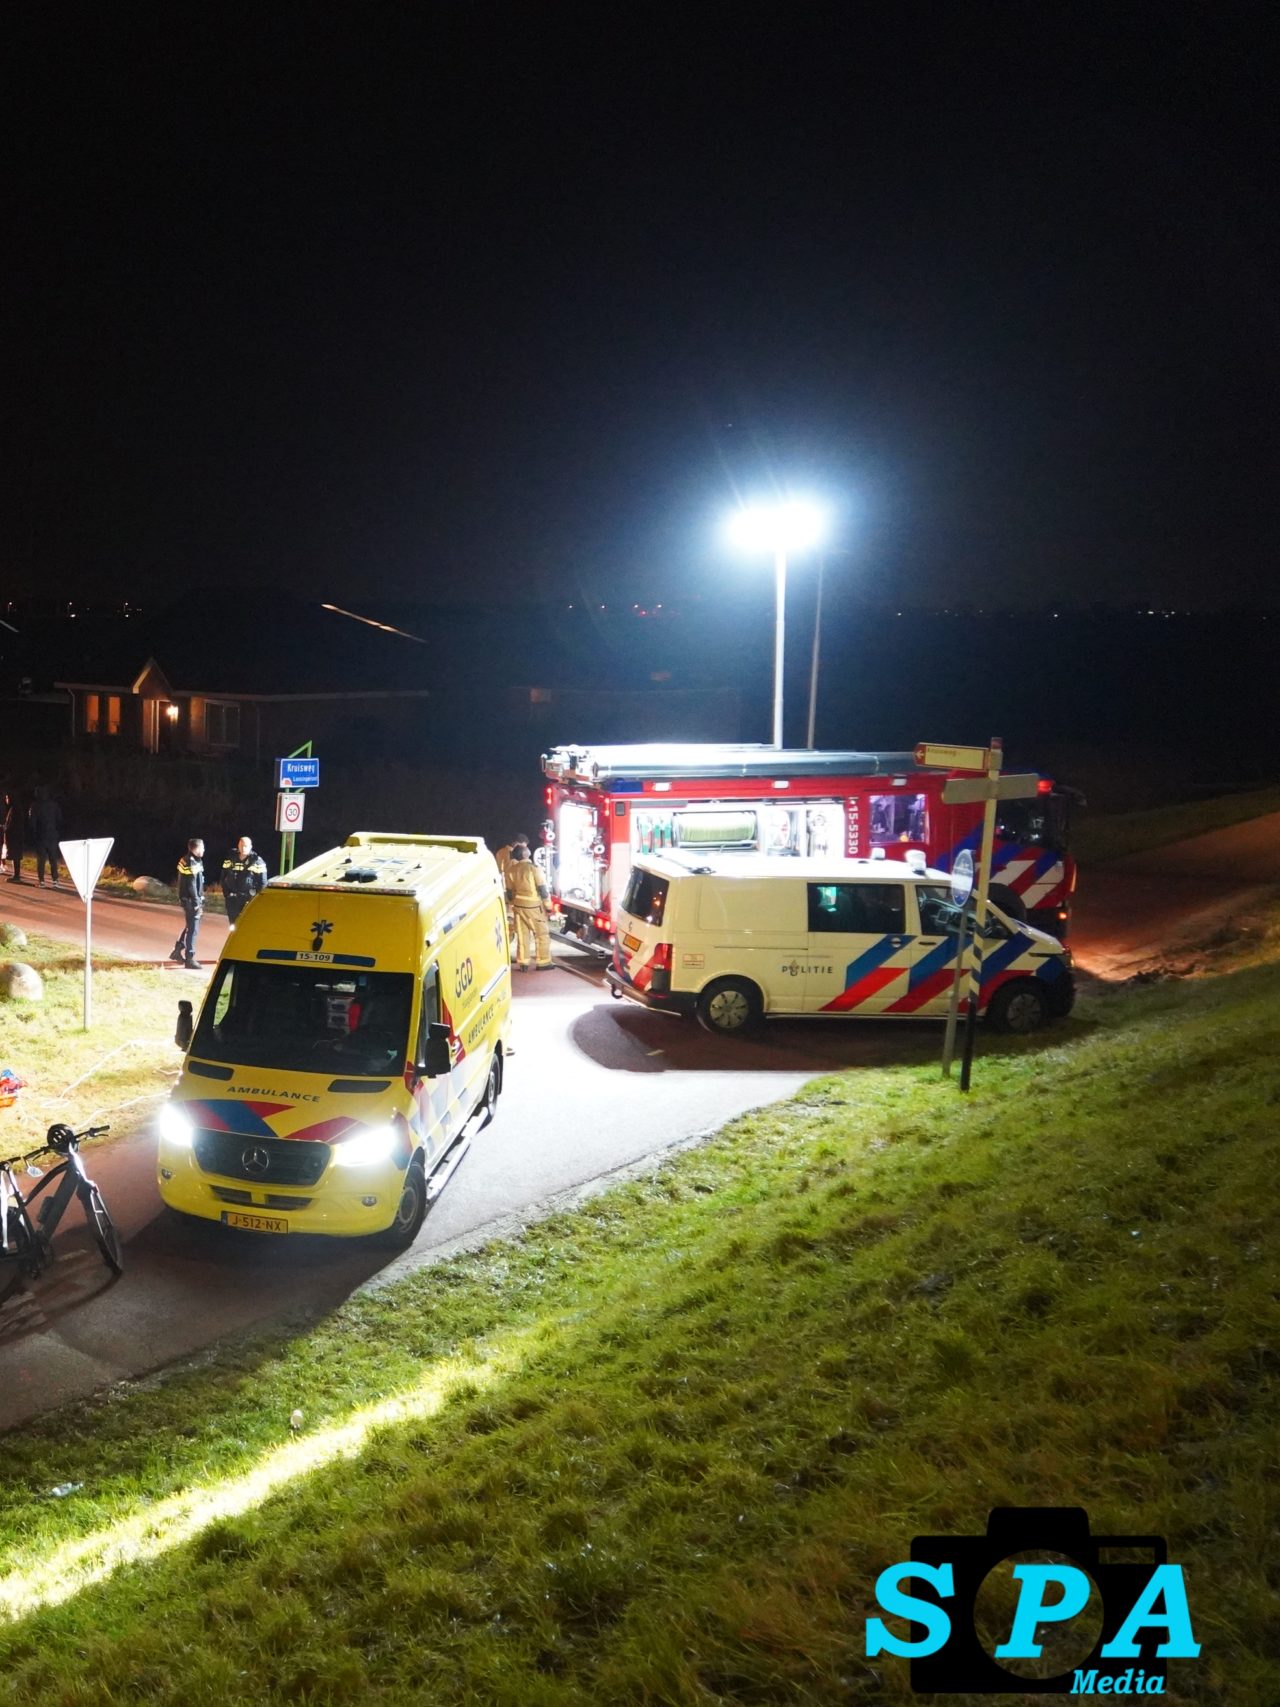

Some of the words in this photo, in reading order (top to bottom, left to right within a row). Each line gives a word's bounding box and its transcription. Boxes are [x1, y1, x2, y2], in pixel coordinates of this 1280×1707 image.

[287, 763, 315, 774] Kruisweg
[288, 808, 298, 817] 30
[848, 805, 859, 855] 15-5330
[299, 953, 331, 961] 15-109
[455, 957, 474, 998] GGD
[468, 1003, 495, 1044] AMBULANCE
[227, 1086, 321, 1102] AMBULANCE
[232, 1215, 281, 1231] J-512-NX
